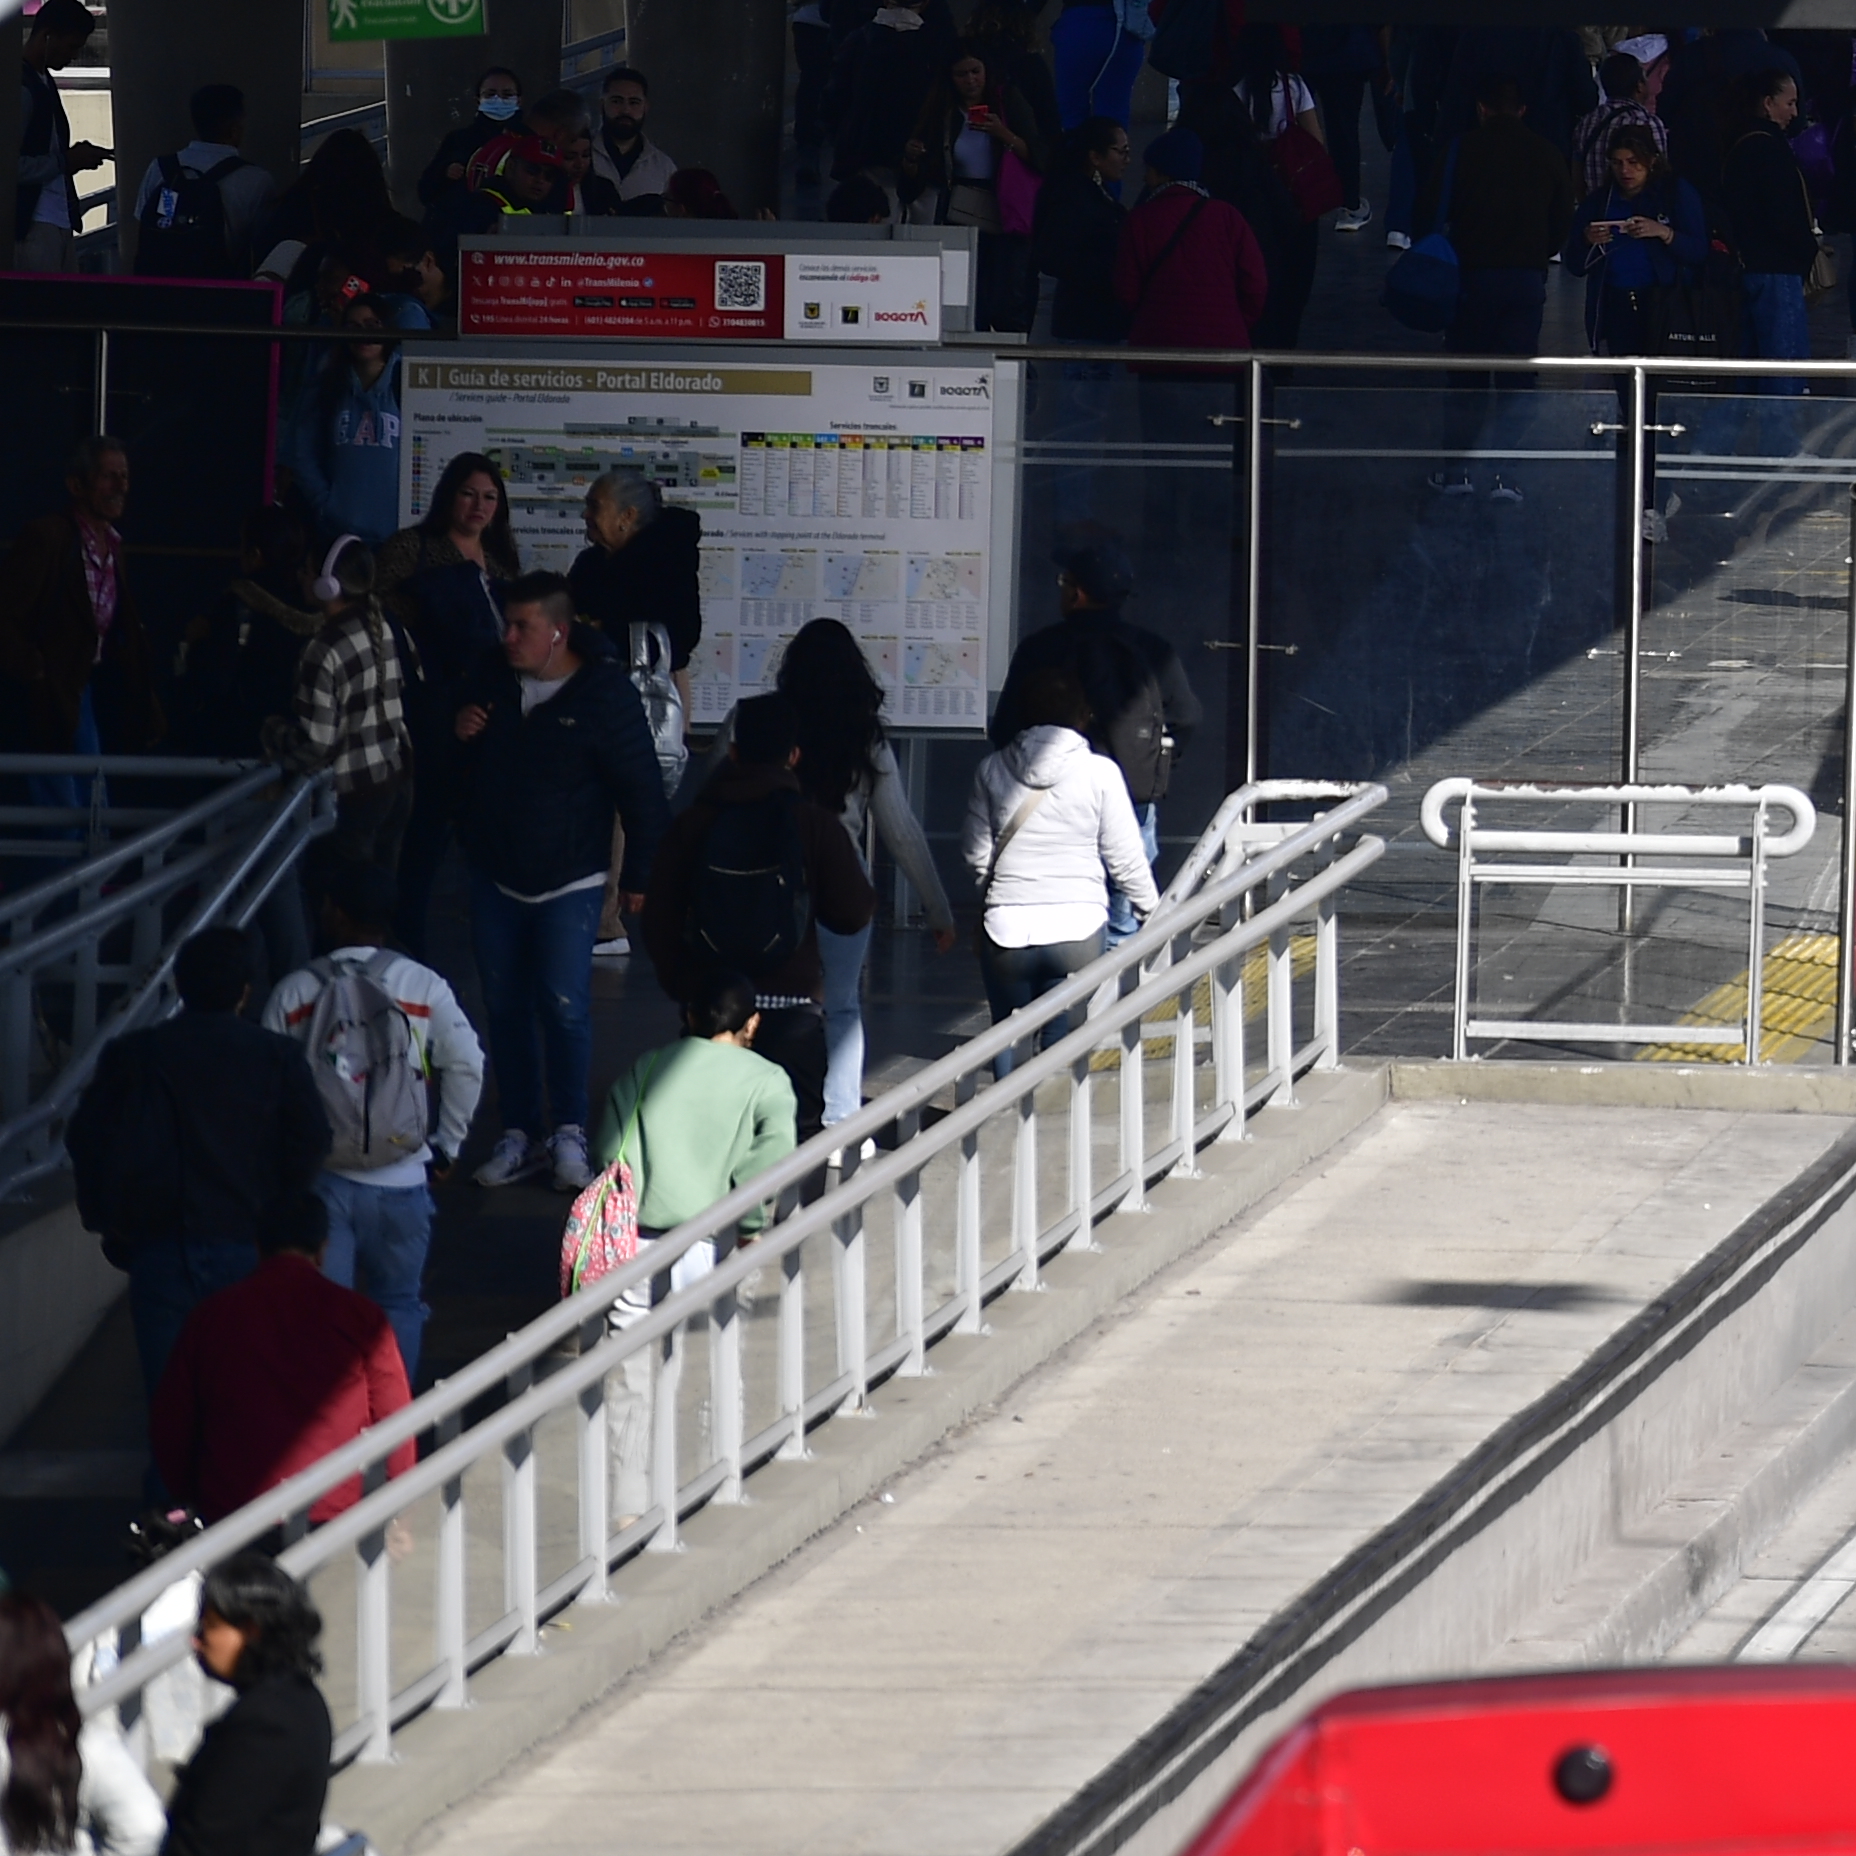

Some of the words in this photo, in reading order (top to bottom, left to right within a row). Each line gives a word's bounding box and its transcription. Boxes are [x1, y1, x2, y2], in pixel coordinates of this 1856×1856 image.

[493, 252, 645, 270] www.transmilenio.gov.co
[1668, 332, 1696, 342] ARTUR
[418, 367, 430, 385] K
[450, 368, 485, 387] Guía
[488, 370, 509, 387] de
[511, 371, 583, 389] servicios
[597, 372, 645, 390] Portal
[650, 373, 722, 391] Eldorado
[413, 413, 435, 423] Plano
[436, 414, 446, 423] de
[447, 413, 483, 424] ubicación
[830, 421, 862, 431] Servicios
[511, 527, 543, 536] ervicios
